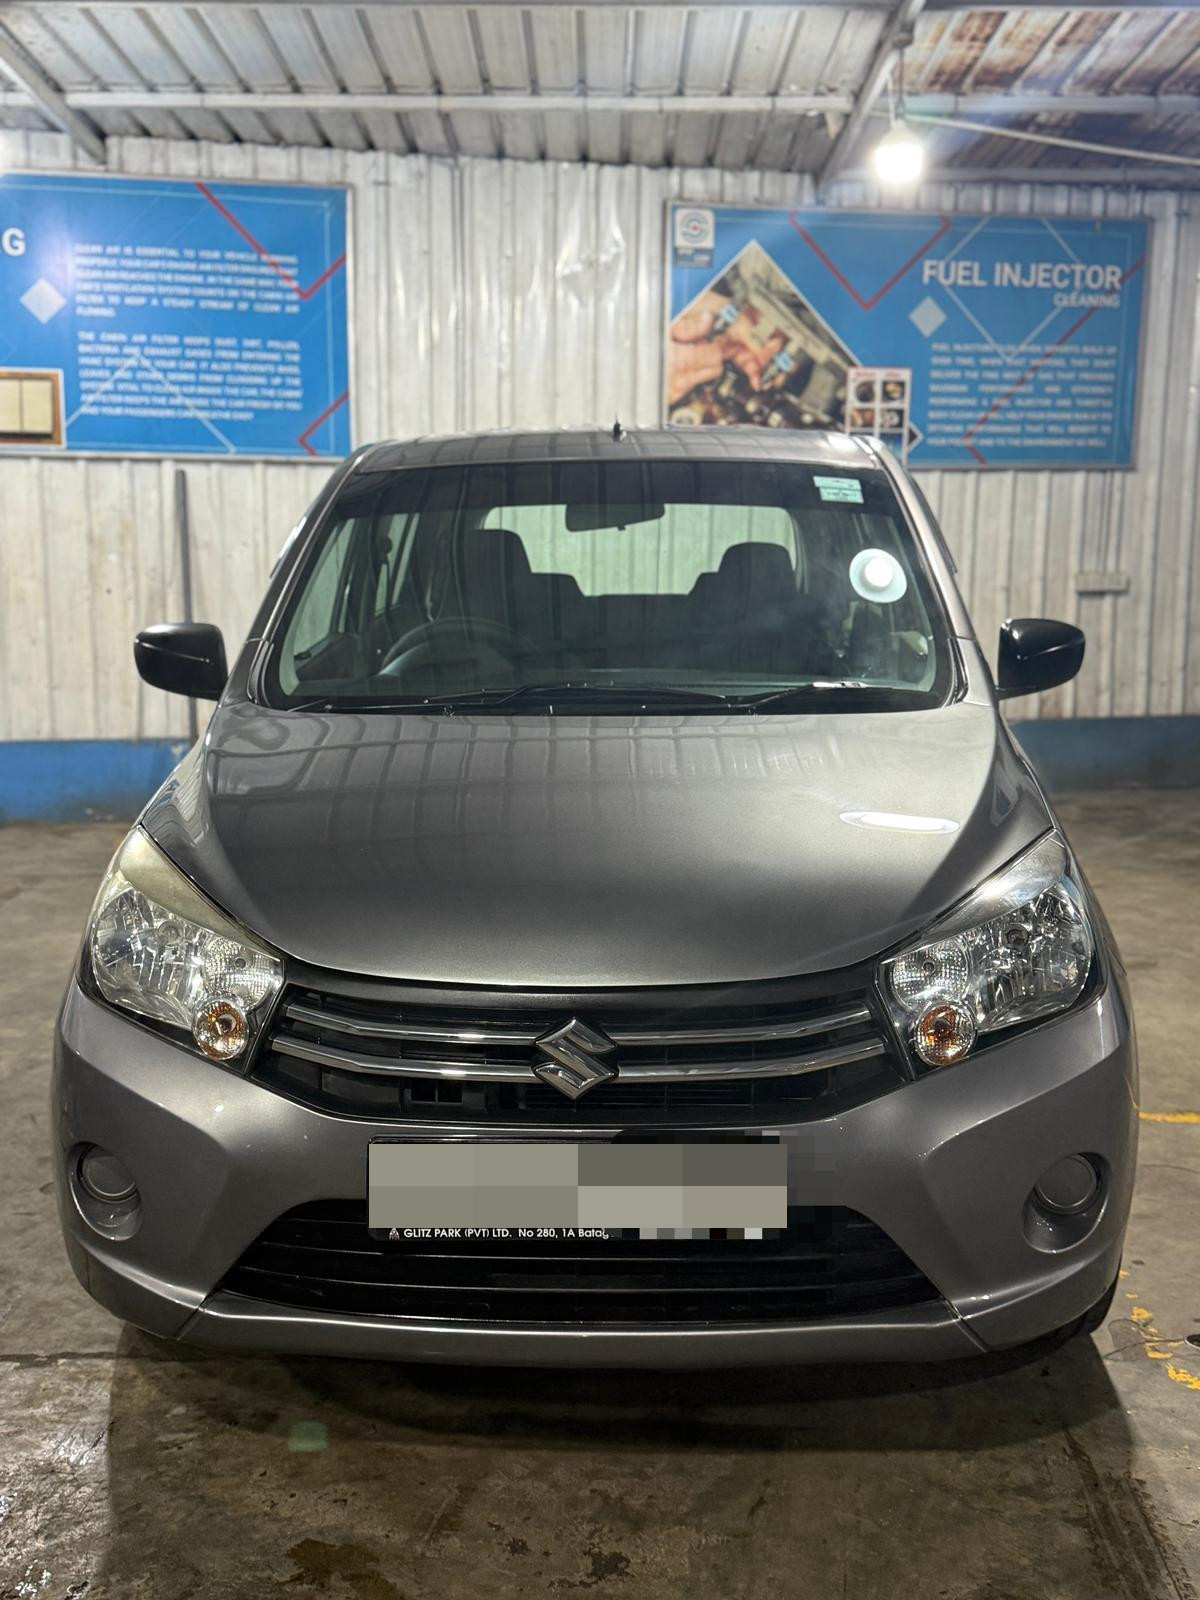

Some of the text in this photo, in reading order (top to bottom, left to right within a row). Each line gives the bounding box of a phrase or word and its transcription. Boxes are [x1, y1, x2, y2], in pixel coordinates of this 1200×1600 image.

[923, 260, 1122, 290] FUEL INJECTOR
[1053, 293, 1121, 309] CLEANING
[403, 1228, 432, 1238] GLITZ
[434, 1228, 462, 1238] PARK
[464, 1228, 490, 1239] (PVT)
[492, 1228, 512, 1238] LTD.
[518, 1228, 534, 1238] No
[536, 1228, 558, 1239] 280,
[562, 1228, 576, 1238] 1A
